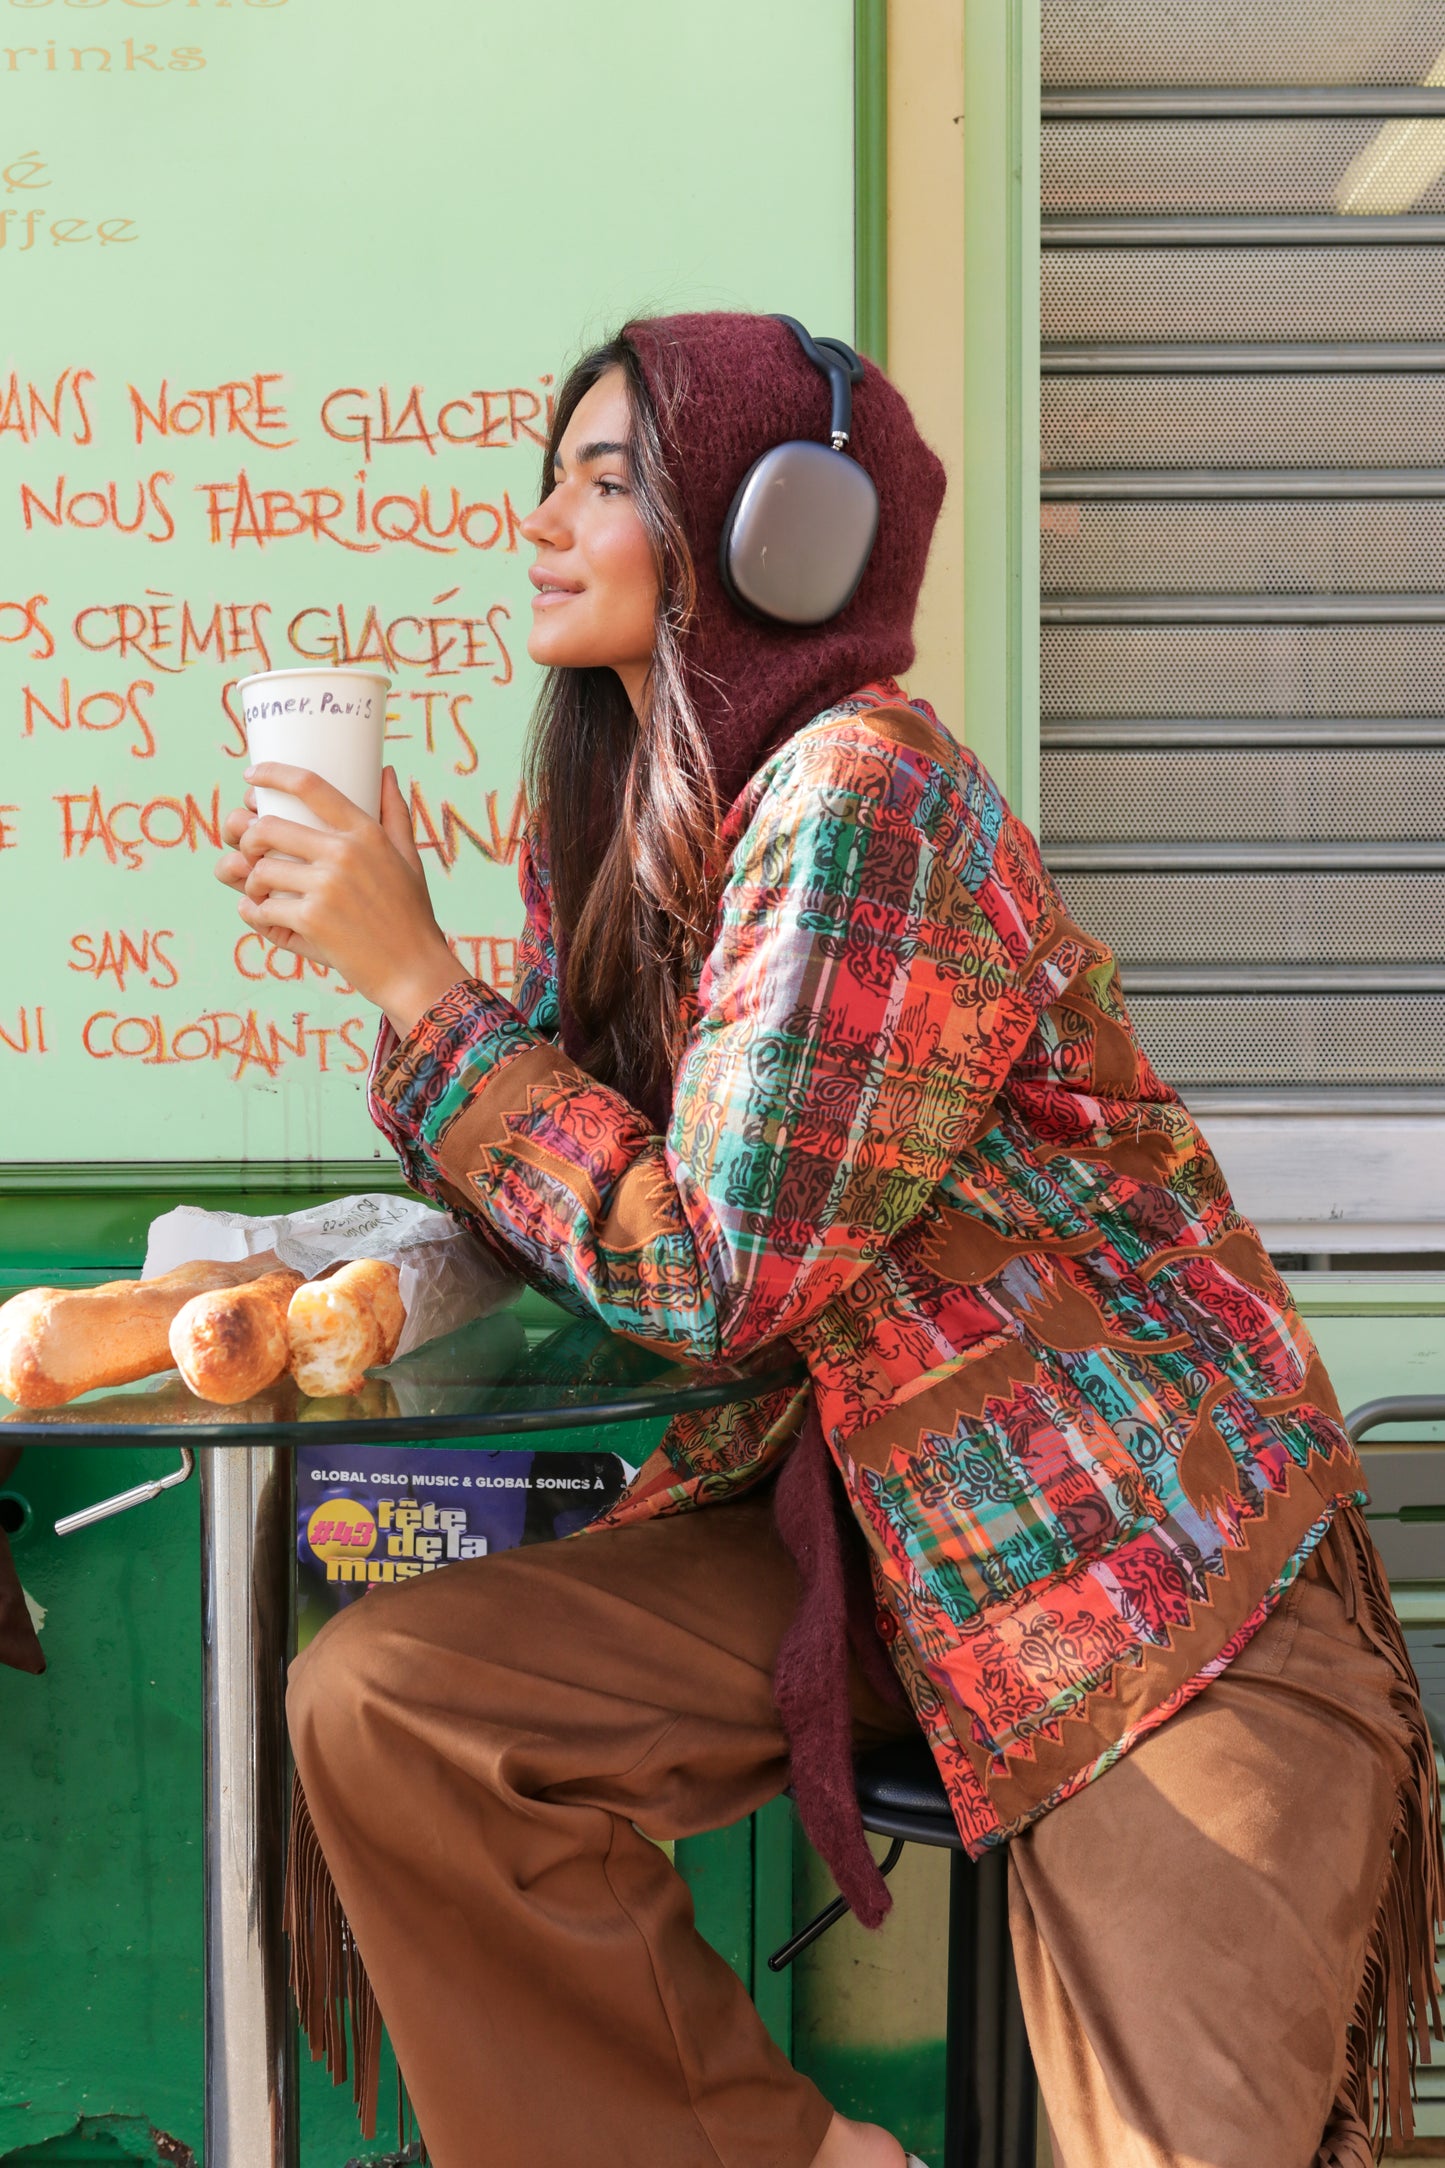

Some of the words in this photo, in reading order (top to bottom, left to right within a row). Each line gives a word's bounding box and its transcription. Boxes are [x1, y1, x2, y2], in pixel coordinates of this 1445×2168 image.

[0, 366, 96, 446] ANS
[129, 373, 298, 449] NOTRE
[21, 470, 175, 542] NOUS
[21, 677, 155, 758] NOS
[52, 784, 224, 871] FAÇON
[67, 928, 179, 993] SANS
[82, 1008, 369, 1081] COLORANTS
[310, 1469, 368, 1484] GLOBAL
[370, 1472, 409, 1486] OSLO
[412, 1474, 460, 1488] MUSIC
[462, 1476, 473, 1488] &
[475, 1476, 533, 1489] GLOBAL
[535, 1478, 591, 1490] SONICS
[593, 1476, 606, 1491] À
[309, 1520, 376, 1547] #43
[326, 1556, 449, 1584] mus
